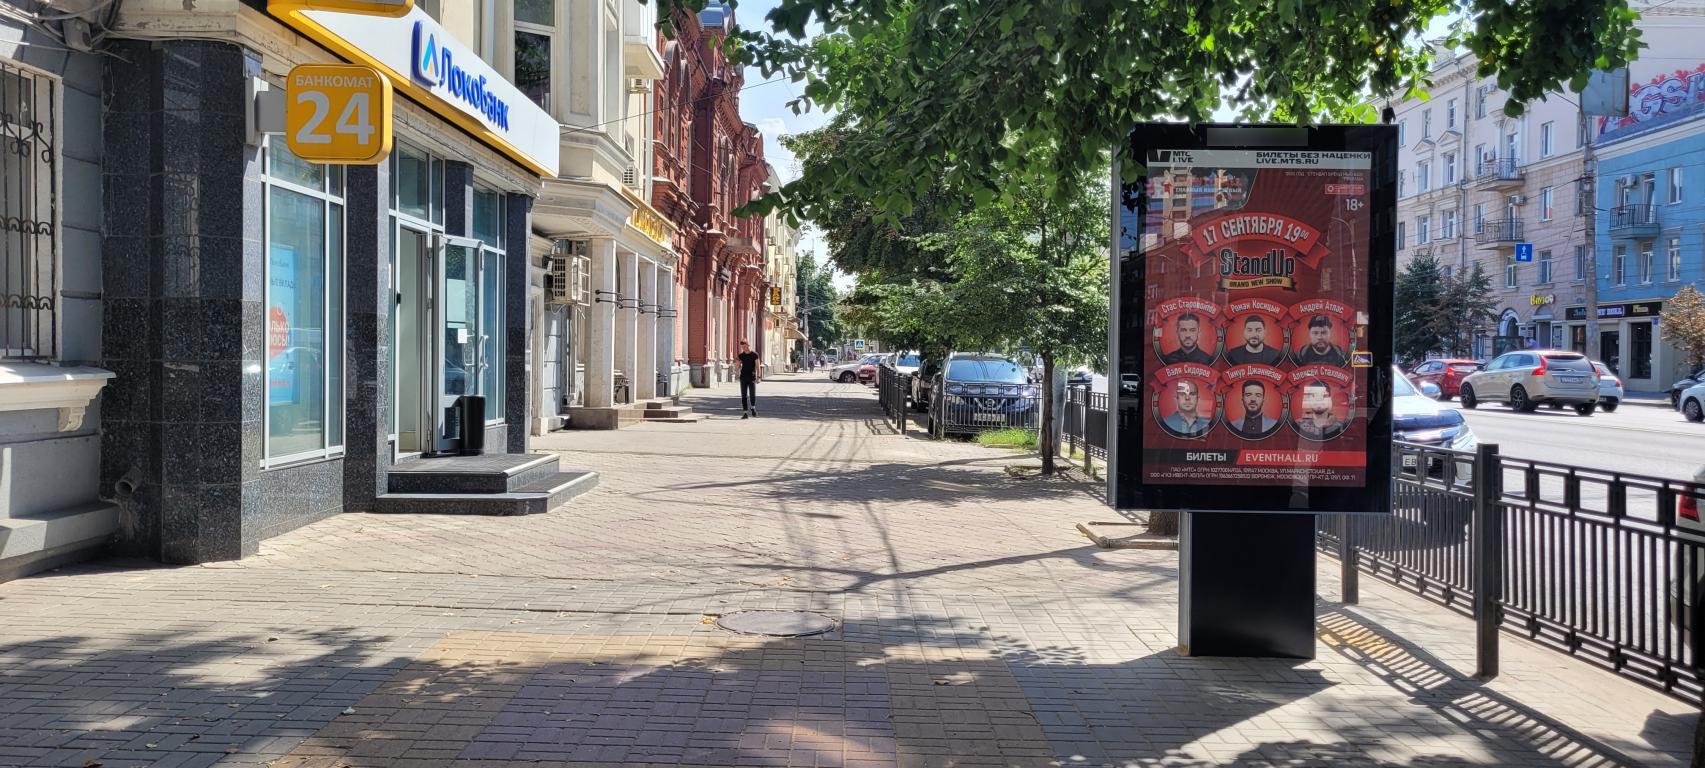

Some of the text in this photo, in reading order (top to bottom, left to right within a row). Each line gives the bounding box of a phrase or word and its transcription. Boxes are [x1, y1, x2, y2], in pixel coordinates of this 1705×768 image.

[295, 75, 374, 88] БАНКОМАТ
[295, 90, 375, 145] 24
[1321, 152, 1371, 160] НАЦЕНКИ
[1345, 198, 1364, 211] 18+
[1202, 225, 1218, 246] 17
[1220, 215, 1284, 239] СЕНТЯБРЯ
[1219, 247, 1296, 278] StandUp
[1229, 277, 1284, 288] BRAND NEW SHOW
[1161, 303, 1178, 313] Стас
[1230, 300, 1281, 314] Роман Косицын
[1299, 300, 1345, 314] Андрей Атлас
[270, 320, 290, 333] ЛЬКО
[1165, 364, 1211, 378] Валя Сидоров
[1225, 368, 1246, 380] Тимур
[1292, 366, 1319, 381] Алексей
[1186, 452, 1227, 462] БИЛЕТЫ
[1245, 453, 1319, 463] EVENTHALL.RU
